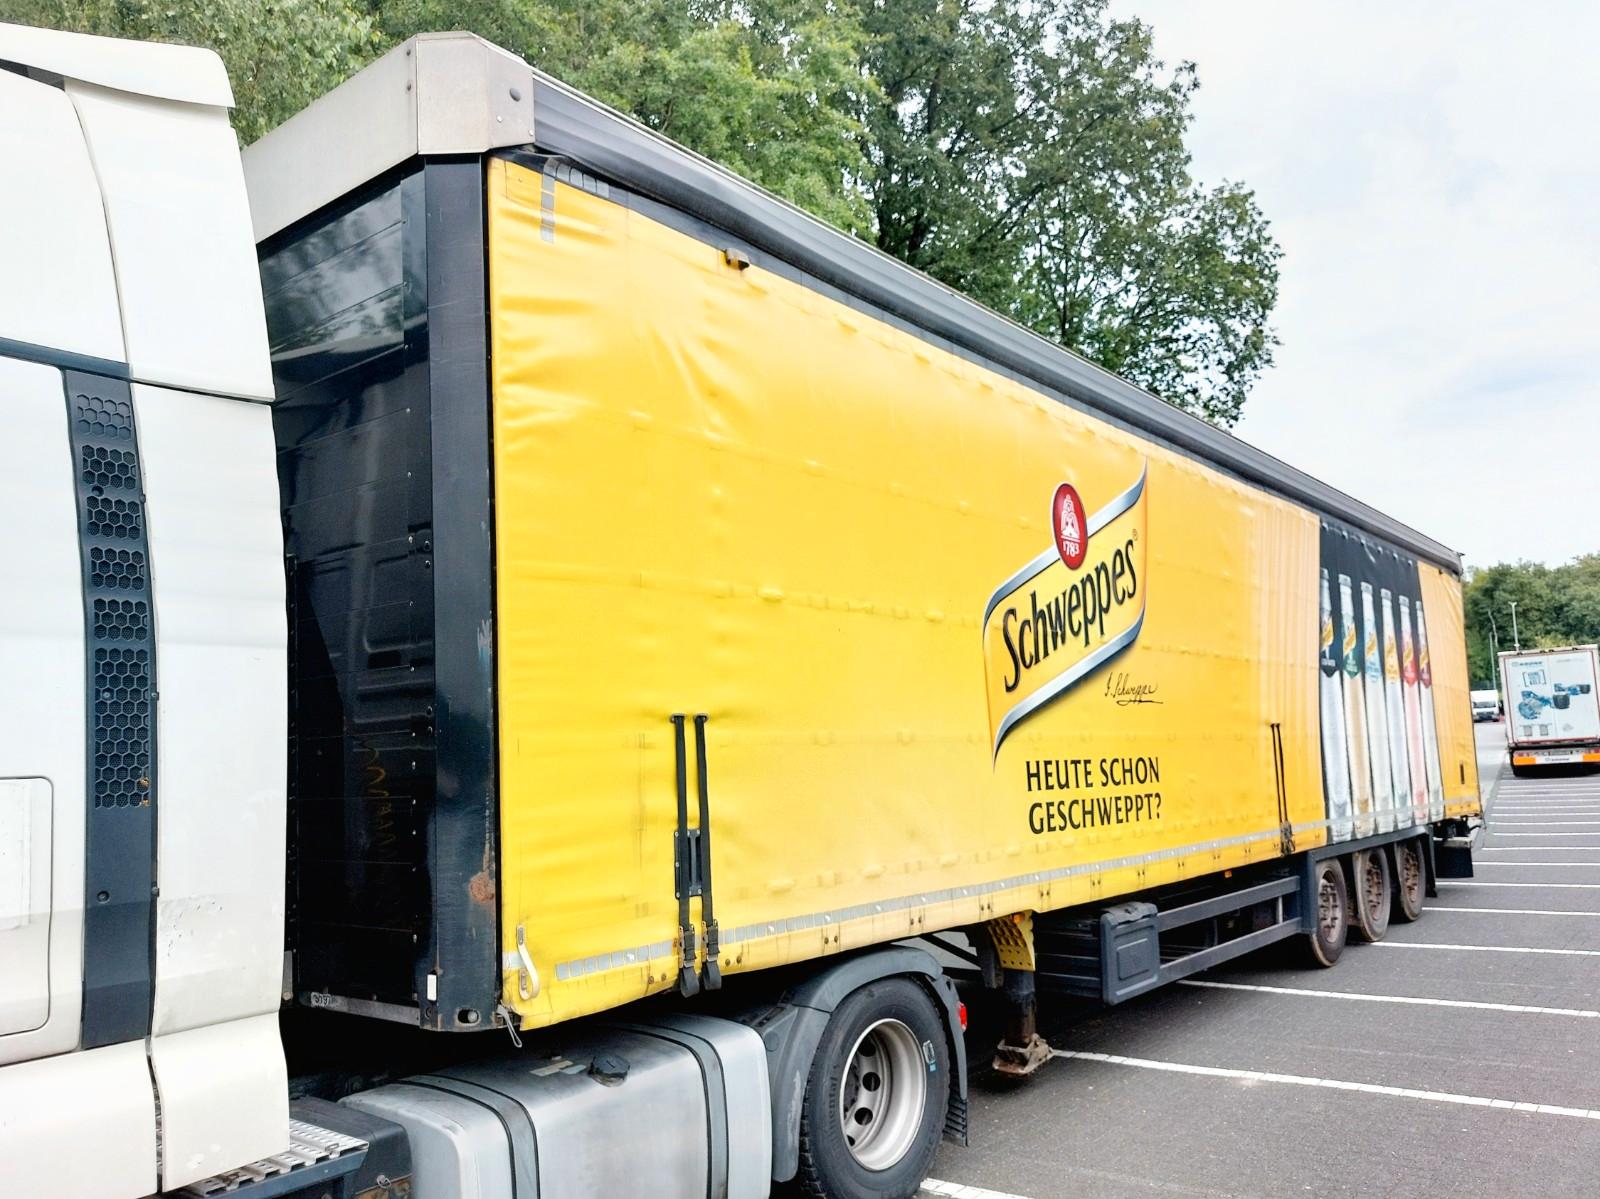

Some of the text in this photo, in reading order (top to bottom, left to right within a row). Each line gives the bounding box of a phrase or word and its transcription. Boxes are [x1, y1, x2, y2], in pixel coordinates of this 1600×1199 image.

[1062, 541, 1080, 557] 1783
[1004, 538, 1137, 693] Schweppes
[1025, 756, 1160, 792] HEUTE SCHON
[1028, 792, 1162, 835] GESCHWEPPT?
